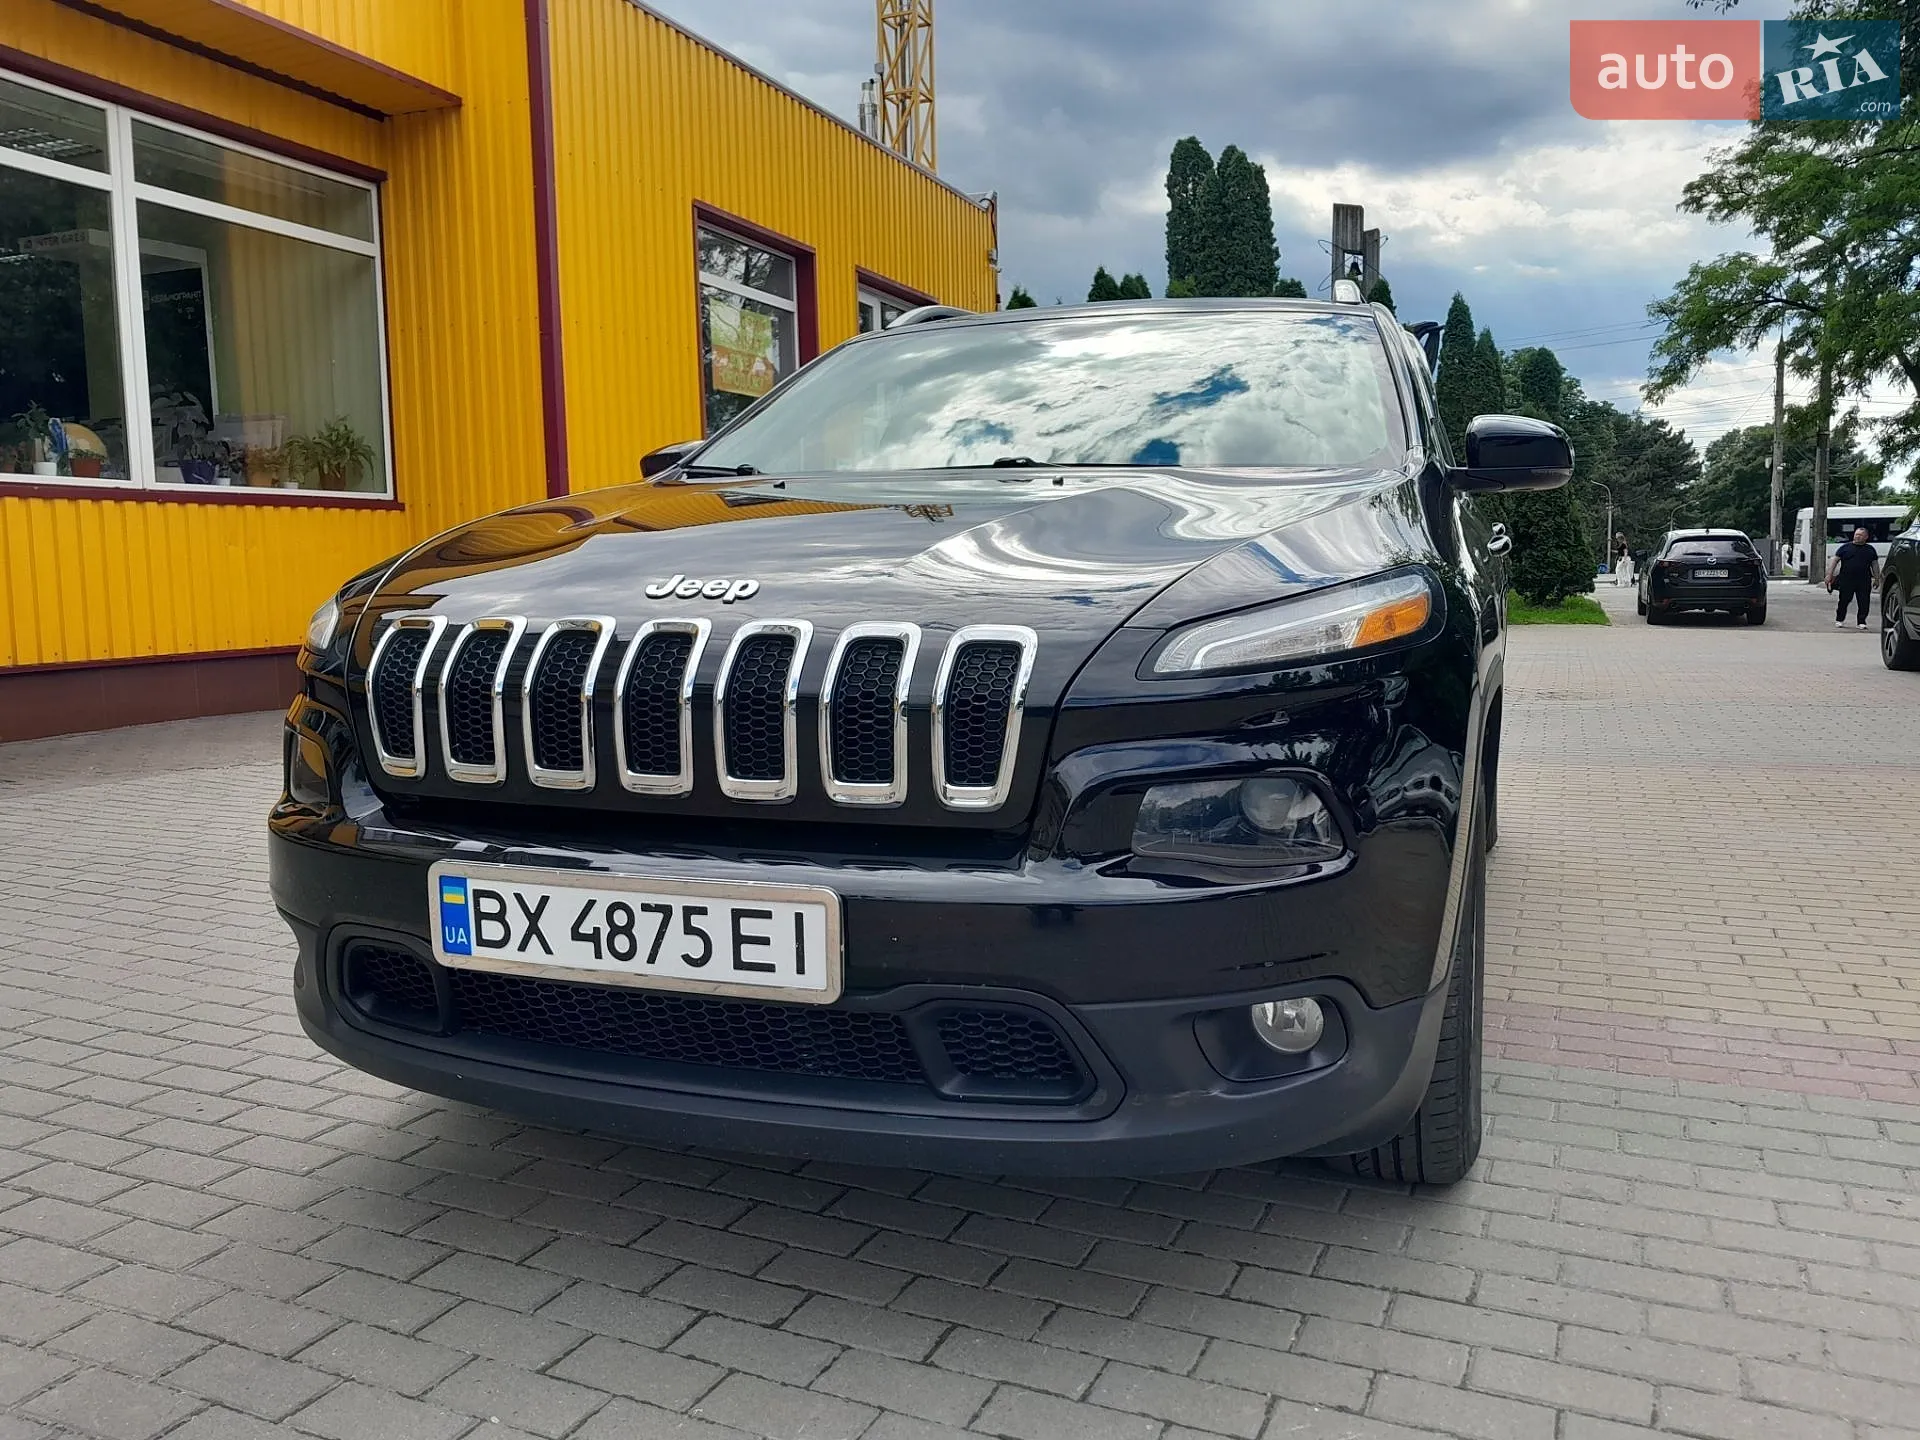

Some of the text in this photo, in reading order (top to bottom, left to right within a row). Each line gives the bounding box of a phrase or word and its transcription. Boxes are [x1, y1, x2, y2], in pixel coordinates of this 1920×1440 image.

[645, 574, 760, 604] Jeep
[445, 925, 469, 945] UA
[472, 888, 806, 975] BX 4875 EI
